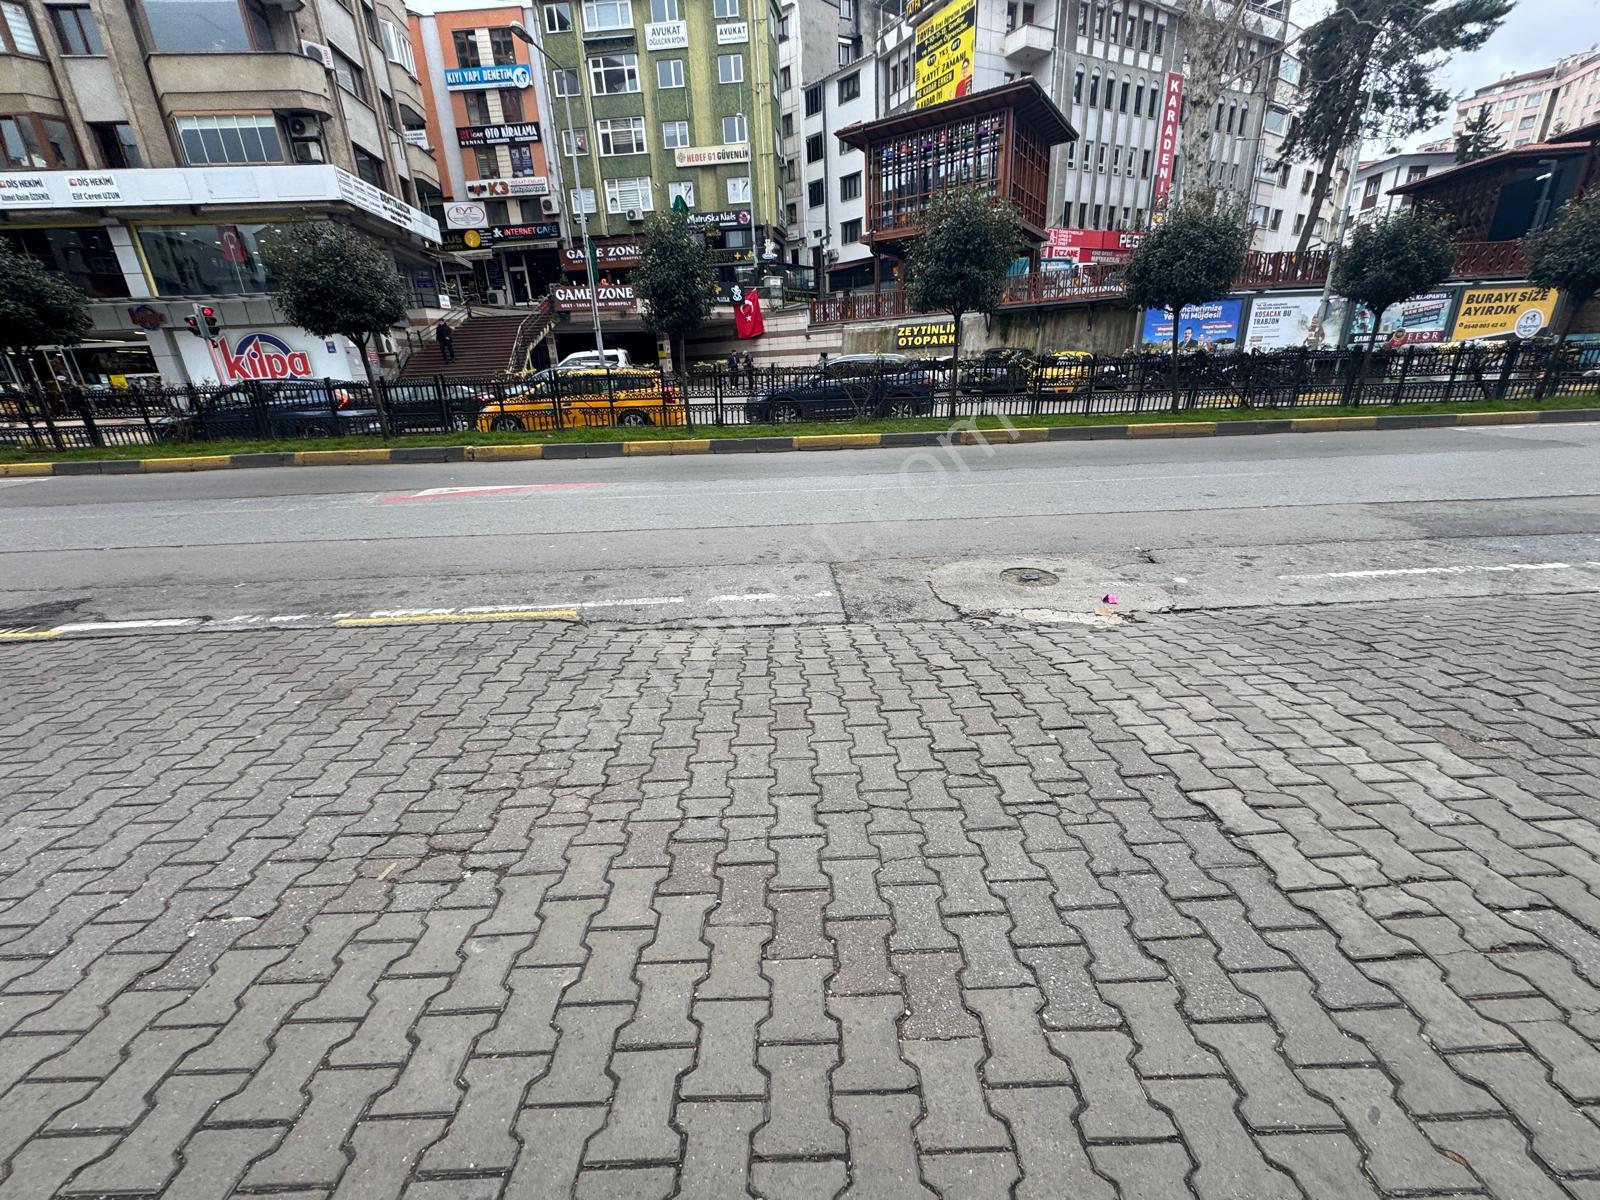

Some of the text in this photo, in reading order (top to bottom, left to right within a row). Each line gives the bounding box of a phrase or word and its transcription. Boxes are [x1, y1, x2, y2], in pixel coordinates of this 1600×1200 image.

[652, 26, 680, 36] AVUKAT
[720, 26, 746, 36] AVUKAT
[446, 68, 513, 84] KIYI YAPI DENETİM
[485, 127, 500, 138] OTO
[501, 124, 537, 138] KİRALAMA
[687, 152, 707, 162] HEDEF
[6, 177, 44, 189] DİŞ HEKİMİ
[77, 176, 114, 187] DİŞ HEKİMİ
[102, 192, 120, 200] UZUN
[537, 225, 558, 234] CAFE
[566, 248, 604, 260] GAE
[598, 287, 634, 299] ZONE
[1465, 289, 1550, 304] BURAYI SİZE
[1461, 304, 1519, 316] AYIRDIK
[218, 336, 312, 380] kilpa
